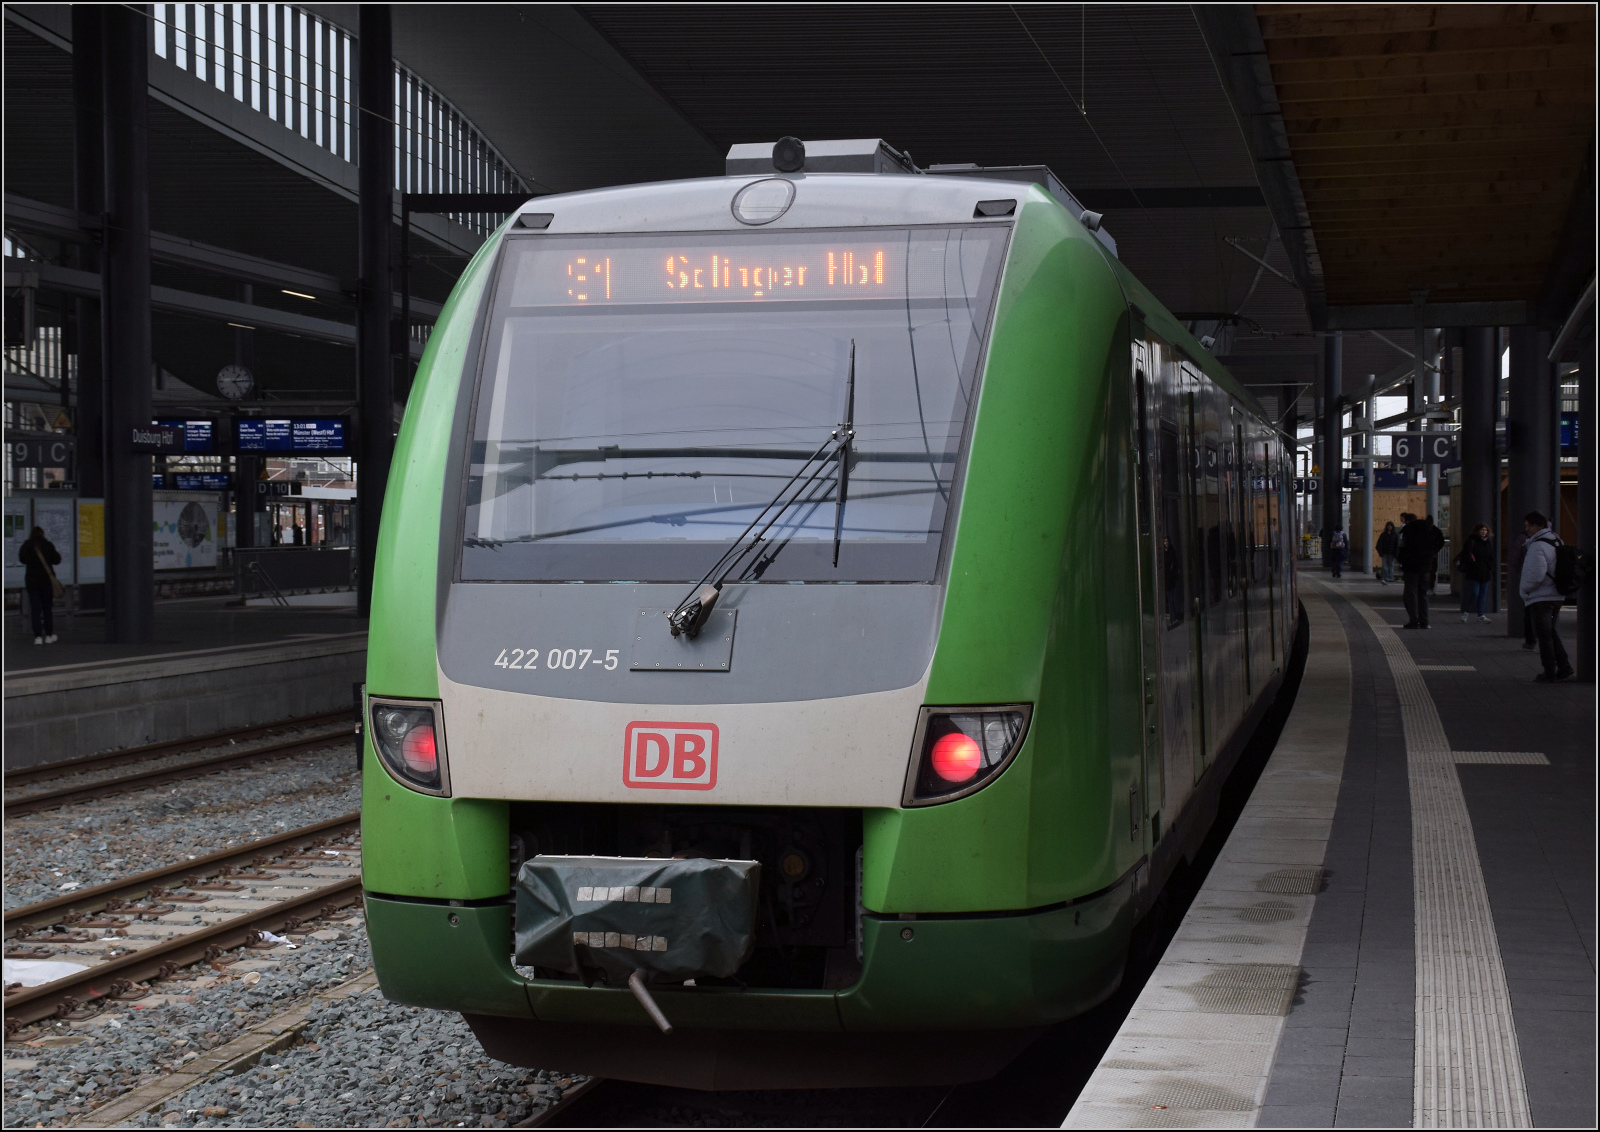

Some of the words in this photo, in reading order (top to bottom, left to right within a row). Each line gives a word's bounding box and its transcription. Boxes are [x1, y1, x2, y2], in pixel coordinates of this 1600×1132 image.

[132, 428, 161, 447] Duisburg
[161, 430, 174, 445] Hbf
[1395, 437, 1410, 458] 6
[1433, 437, 1449, 458] C
[15, 442, 28, 462] 9
[50, 442, 66, 463] C
[258, 483, 267, 494] D
[275, 483, 288, 494] 10
[1309, 479, 1318, 491] D
[493, 648, 540, 670] 422
[546, 648, 620, 671] 007-5
[633, 731, 708, 780] DB
